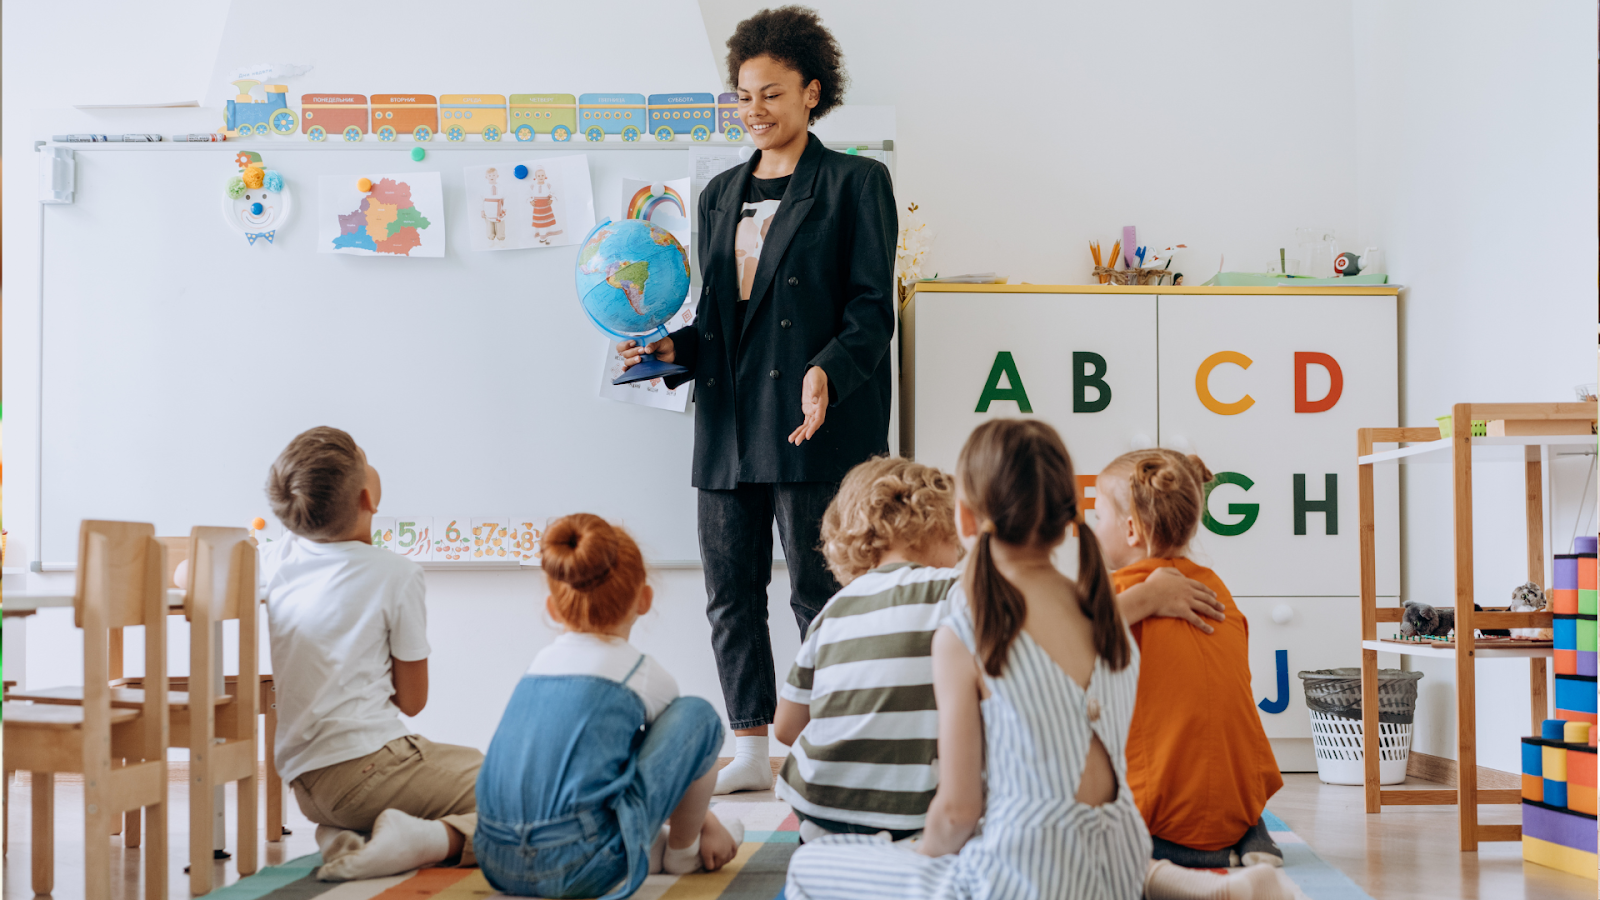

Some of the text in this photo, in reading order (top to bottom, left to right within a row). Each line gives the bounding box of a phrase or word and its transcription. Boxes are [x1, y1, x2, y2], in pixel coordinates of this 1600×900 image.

[974, 350, 1344, 416] A B C D
[1202, 471, 1260, 537] G
[1293, 473, 1339, 536] H
[398, 521, 417, 548] 5
[445, 520, 461, 543] 6
[482, 522, 499, 544] 7
[521, 531, 535, 551] 8
[1257, 649, 1289, 714] J
